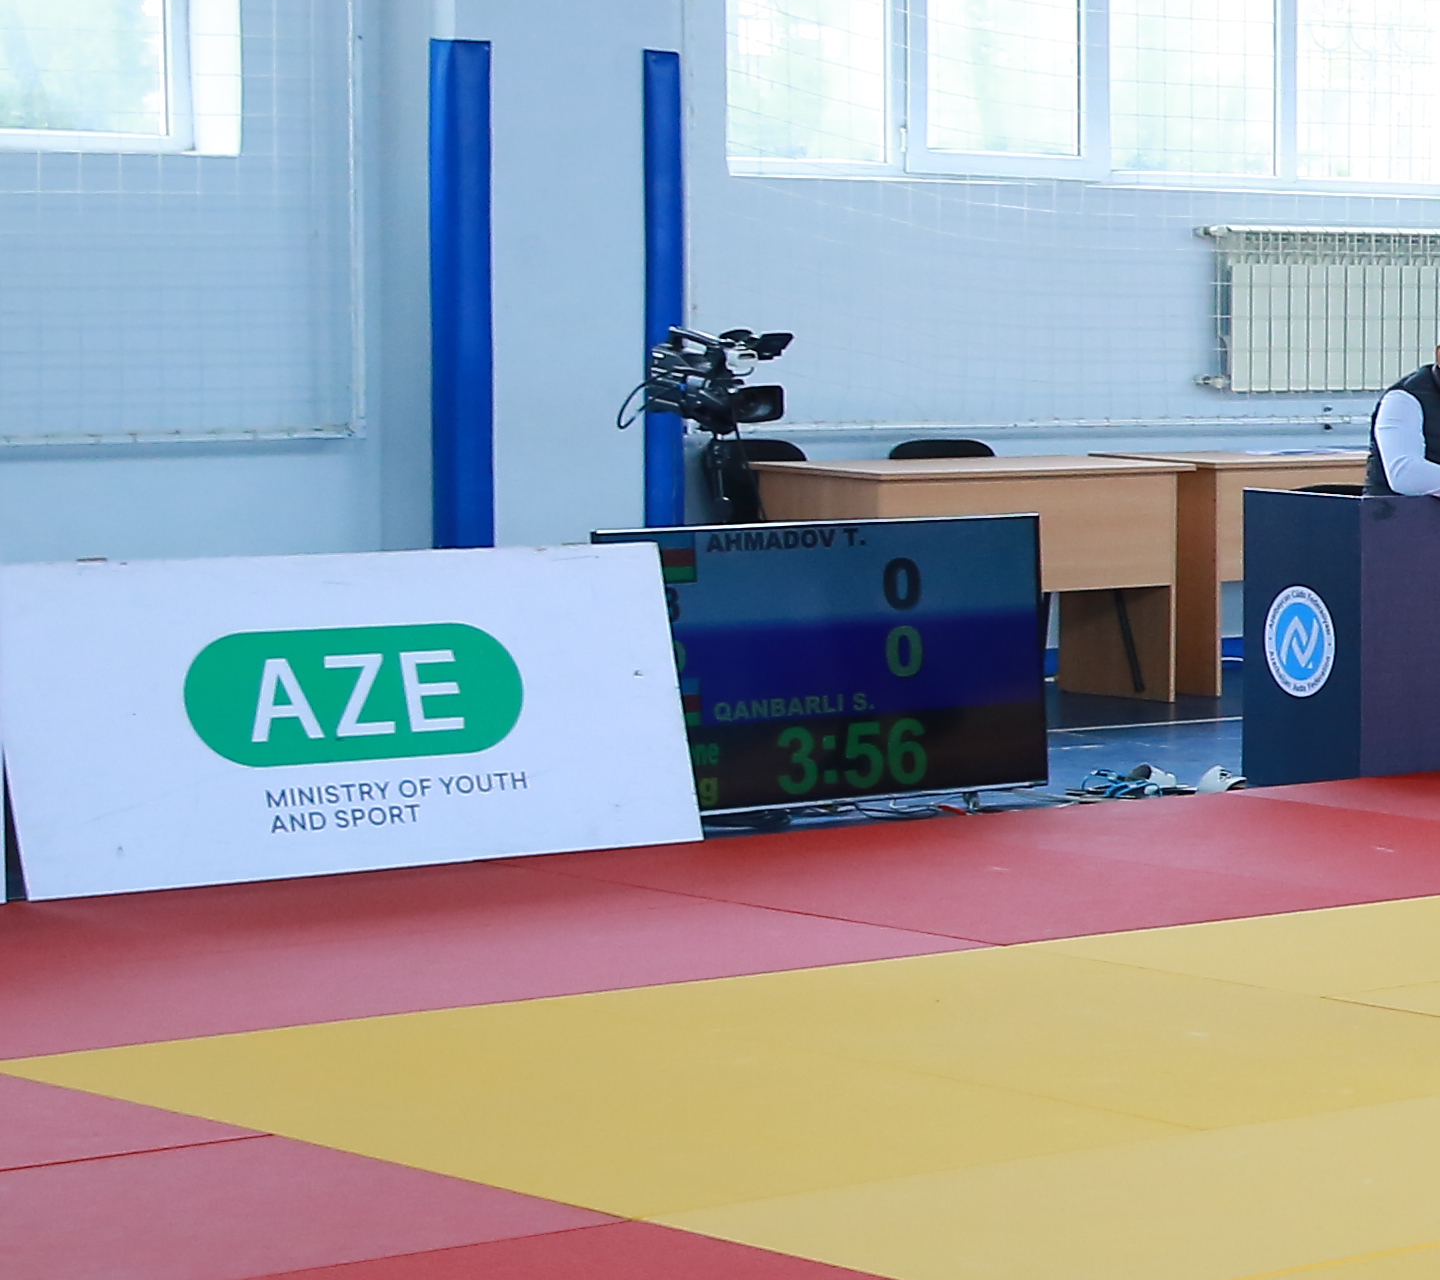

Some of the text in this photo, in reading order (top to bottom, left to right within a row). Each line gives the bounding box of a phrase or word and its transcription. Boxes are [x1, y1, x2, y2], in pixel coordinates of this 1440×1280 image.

[707, 528, 868, 553] AHMADOV T.
[882, 557, 922, 611] 0
[885, 625, 923, 677] 0
[251, 649, 465, 743] AZE
[714, 693, 875, 721] QANBARLI S.
[777, 718, 929, 795] 3:56
[265, 771, 529, 809] MINISTRY OF YOUTH
[271, 804, 420, 834] AND SPORT
